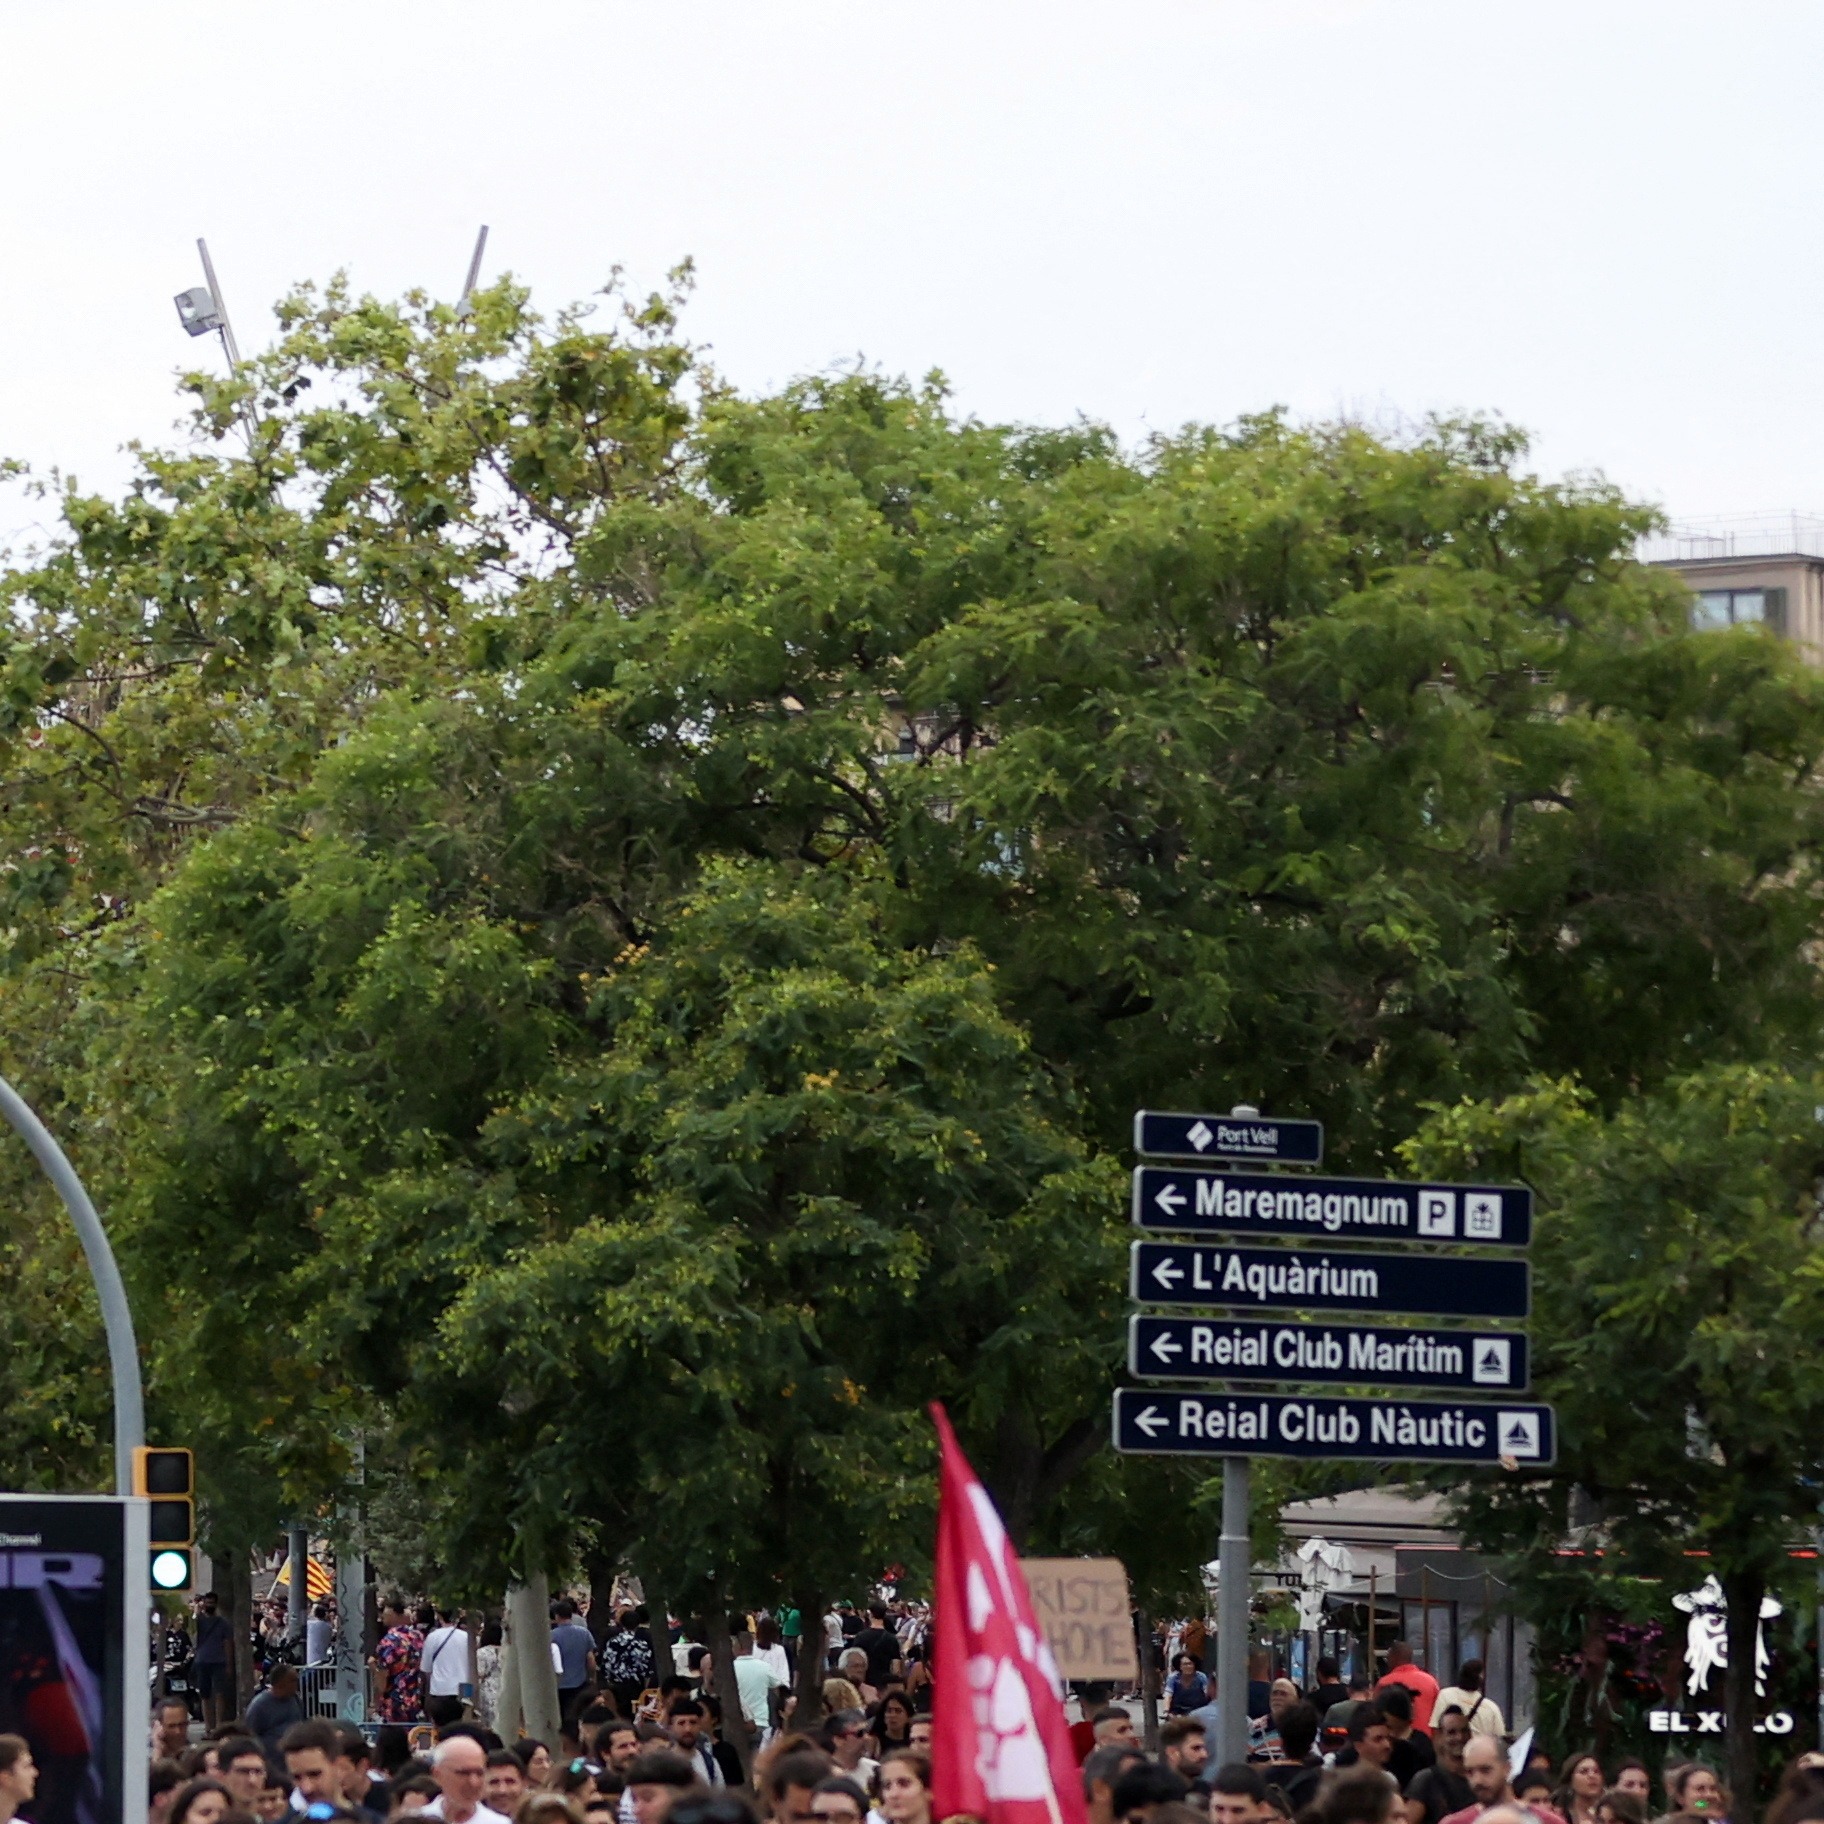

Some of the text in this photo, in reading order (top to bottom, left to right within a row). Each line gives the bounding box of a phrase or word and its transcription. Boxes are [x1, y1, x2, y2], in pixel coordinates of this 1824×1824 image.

[1217, 1125, 1279, 1146] Port Vell
[1196, 1178, 1409, 1231] Maremagnum
[1193, 1252, 1378, 1301] L'Aquàrium
[1191, 1326, 1464, 1375] Reial Club Marítim
[1179, 1400, 1487, 1448] Reial Club Nàutic
[1033, 1576, 1124, 1616] RISTS
[1047, 1620, 1130, 1666] HOME
[1649, 1711, 1794, 1734] EL XO
